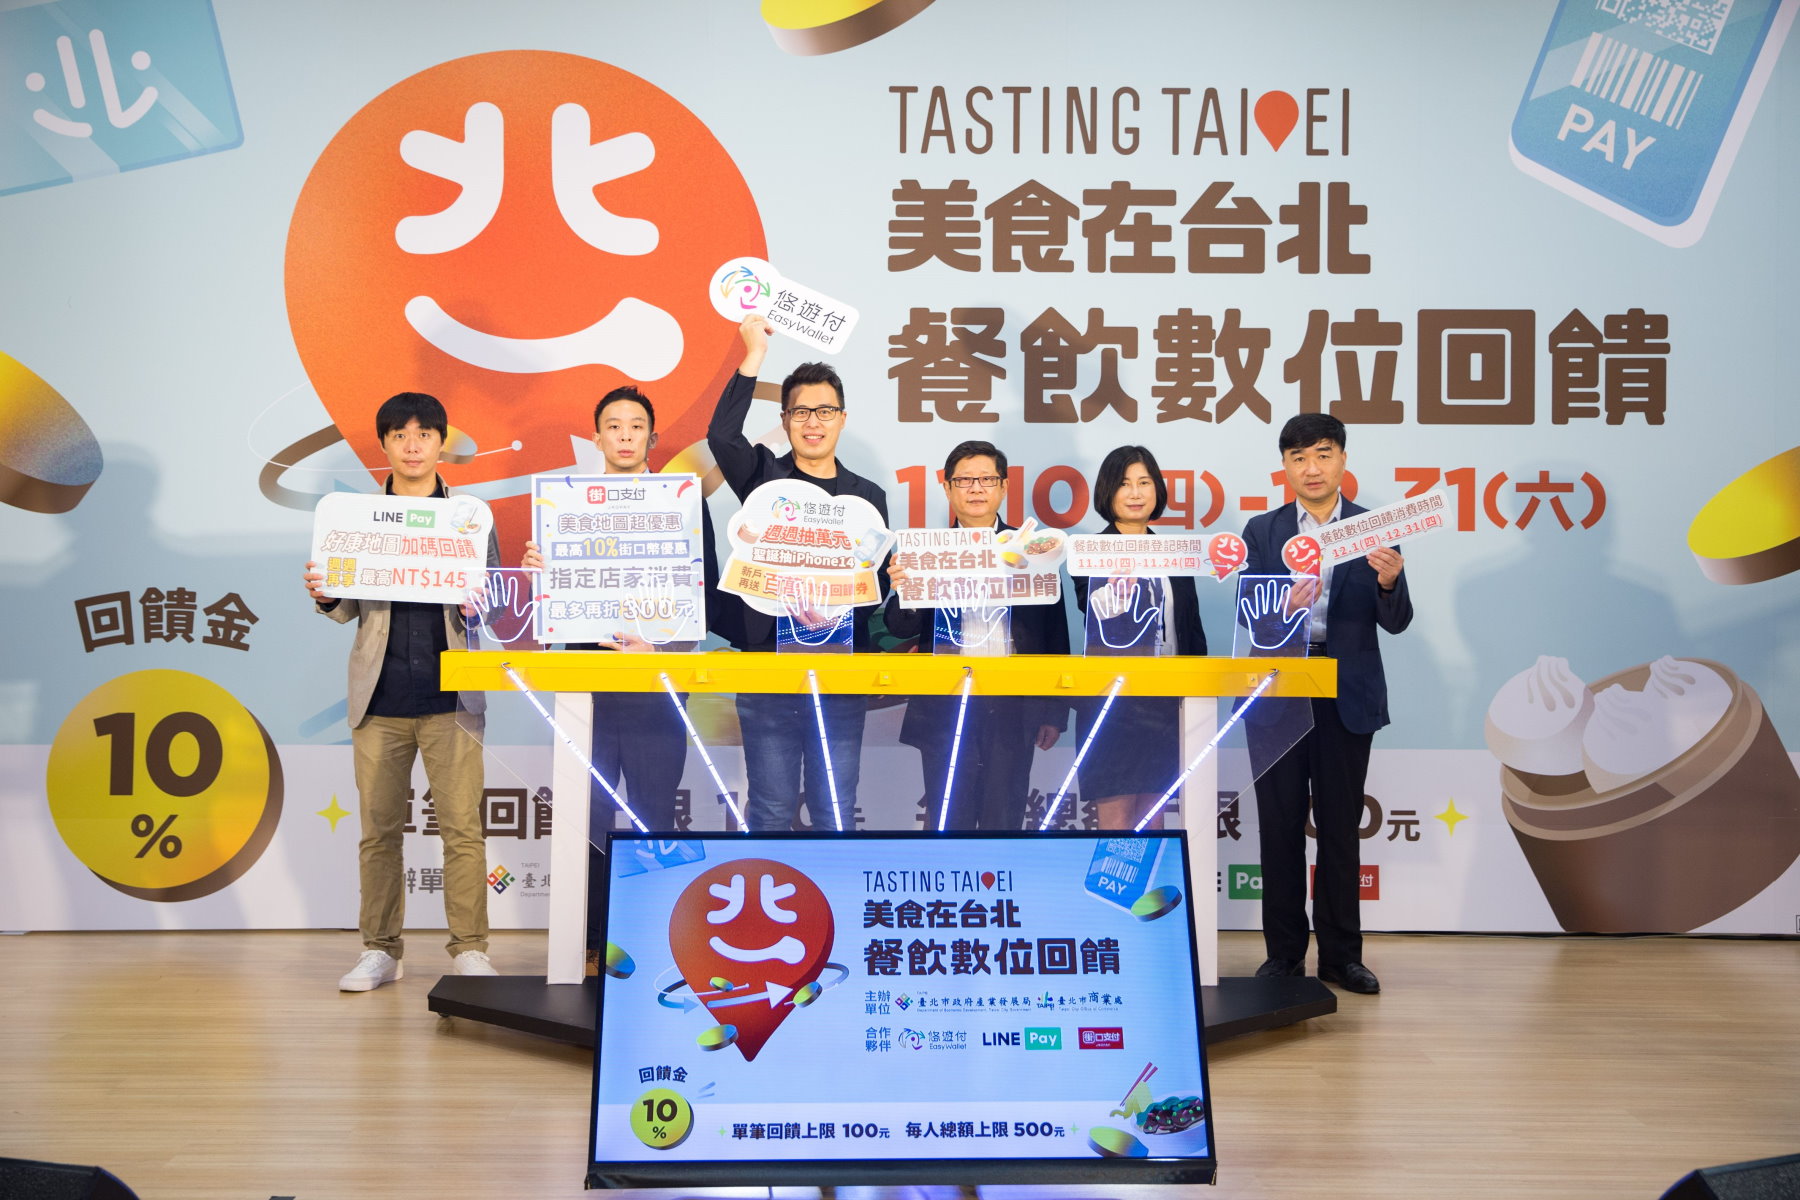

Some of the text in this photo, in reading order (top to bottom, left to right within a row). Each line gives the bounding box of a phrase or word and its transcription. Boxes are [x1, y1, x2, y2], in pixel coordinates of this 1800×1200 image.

[889, 85, 1141, 155] TASTING
[1556, 103, 1657, 171] PAY
[888, 178, 1372, 275] 美食在台北
[773, 289, 847, 332] 悠遊付
[767, 309, 835, 345] EasyWallet
[887, 305, 1671, 427] 餐飲數位回饋
[588, 487, 647, 502] 街口支付
[373, 511, 433, 526] LINE Pay
[804, 501, 846, 516] 悠遊付
[1320, 494, 1444, 545] 餐飲數位回饋消費時間
[560, 513, 682, 533] 美食地圖超優惠
[803, 516, 844, 526] EasyWallet
[321, 530, 478, 559] 好康地圖加碼回饋
[554, 537, 689, 558] 最高10%街口幣優惠
[760, 524, 852, 550] 週週抽萬元
[899, 531, 950, 547] TASTING
[1074, 539, 1202, 552] 餐飲數位回饋登記時間
[327, 556, 357, 572] 週週
[752, 547, 856, 569] 聖誕抽iPhone14
[899, 549, 998, 571] 美食在台北
[360, 567, 468, 589] 最高NT$145
[549, 565, 692, 589] 指定店家消費
[901, 572, 1058, 601] 餐飲數位回饋
[74, 587, 260, 653] 回饋金
[93, 711, 223, 797] 10
[131, 813, 182, 859] %
[863, 870, 945, 893] TASTING
[1097, 876, 1127, 896] PAY
[863, 898, 1022, 929] 美食在台北
[863, 937, 1120, 976] 餐飲數位回饋
[865, 990, 891, 1002] 主辦
[865, 1003, 891, 1015] 單位
[865, 1027, 892, 1039] 合作
[982, 1032, 1058, 1050] LINE Pay
[865, 1039, 892, 1053] 夥伴
[929, 1042, 967, 1051] EasyWallet
[639, 1065, 688, 1083] 回饋金
[643, 1098, 678, 1122] 10
[652, 1126, 667, 1139] %
[731, 1121, 1065, 1140] 單筆回饋上限 100元 每人總額上限 500元
